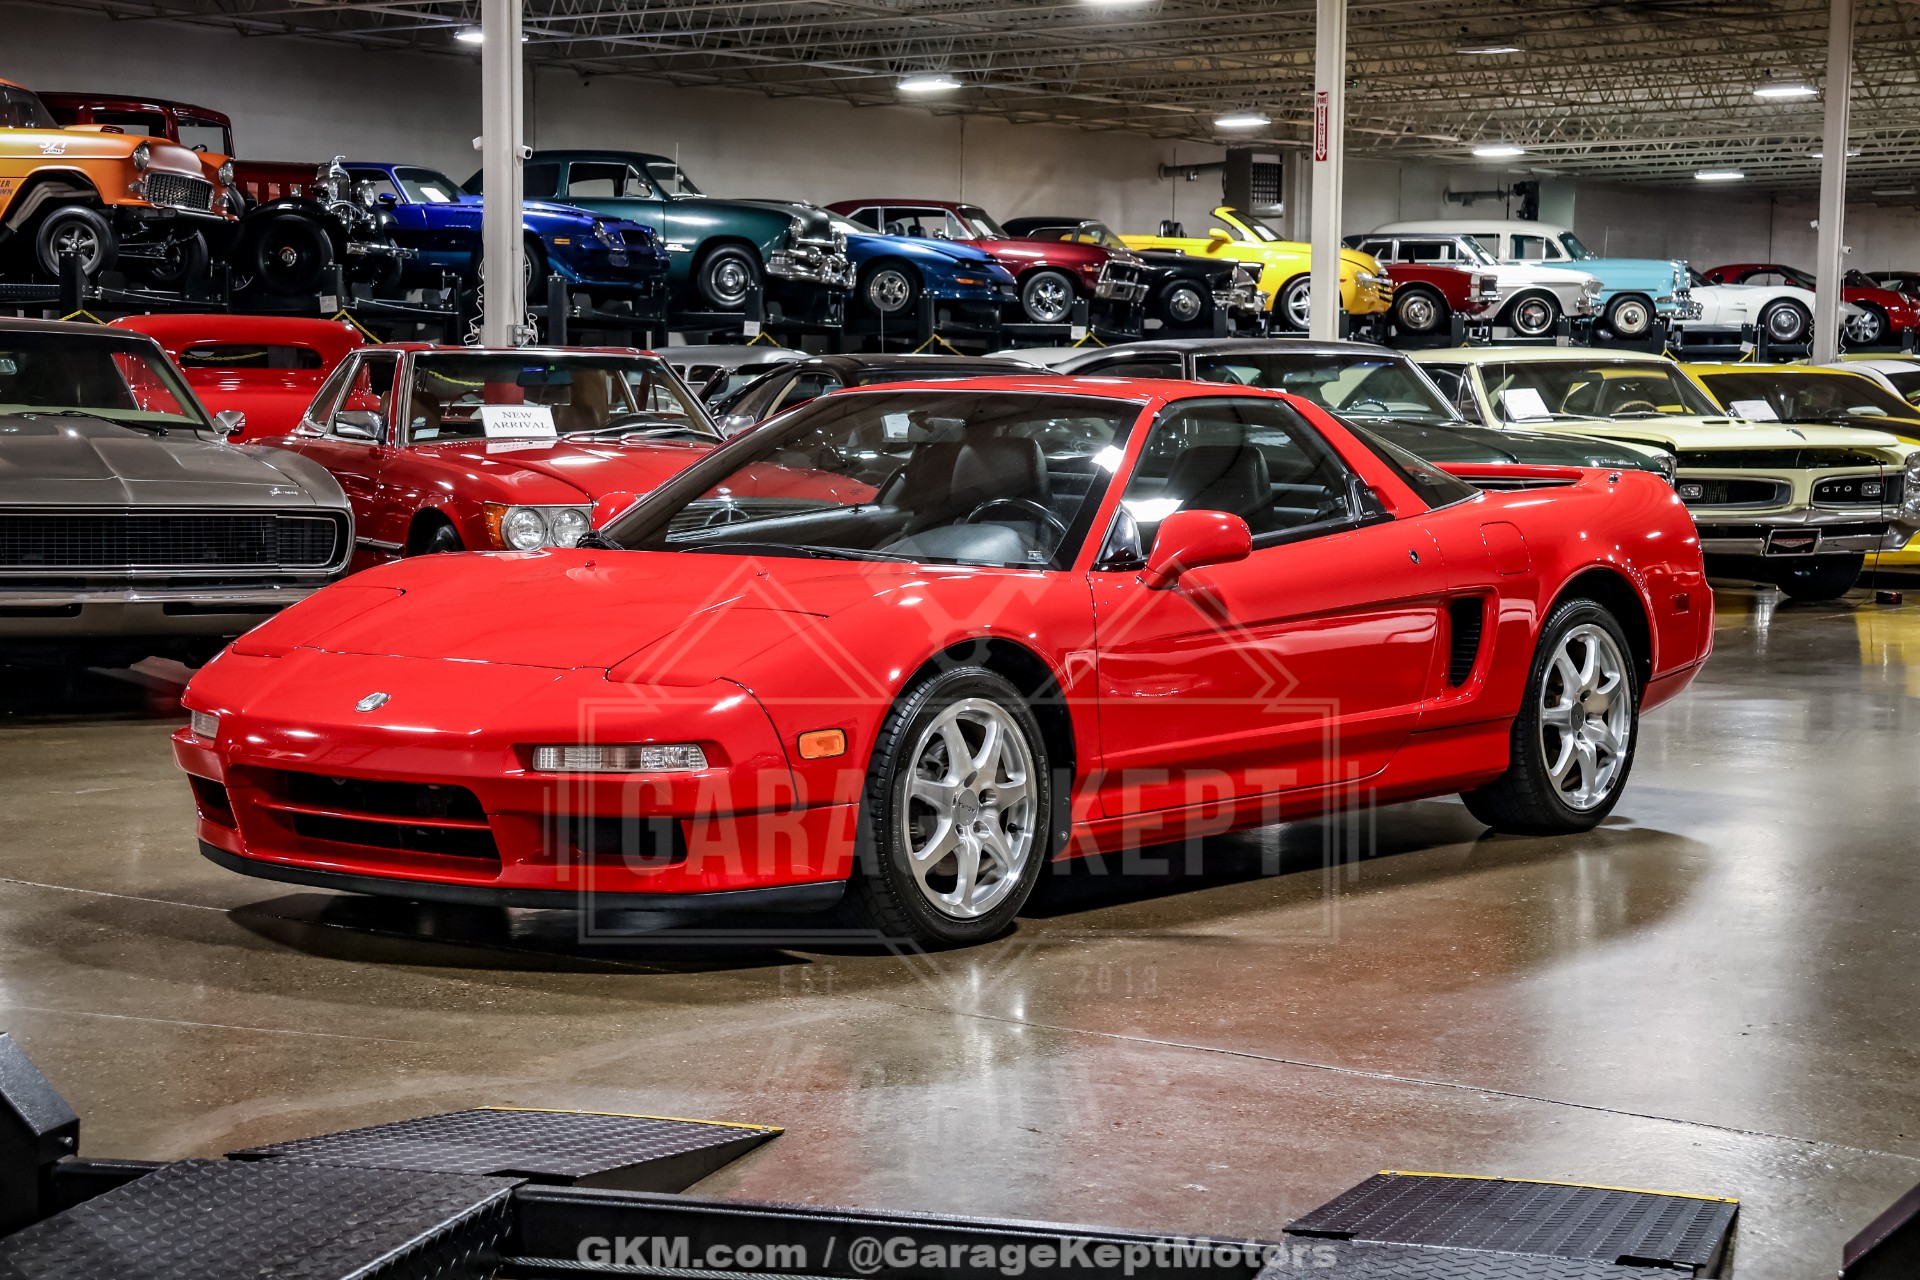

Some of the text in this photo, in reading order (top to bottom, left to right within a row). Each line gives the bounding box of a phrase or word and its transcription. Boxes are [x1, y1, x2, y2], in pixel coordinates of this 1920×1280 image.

[502, 411, 532, 419] NEW
[492, 421, 549, 429] ARRIVAL
[1821, 485, 1852, 493] GTO
